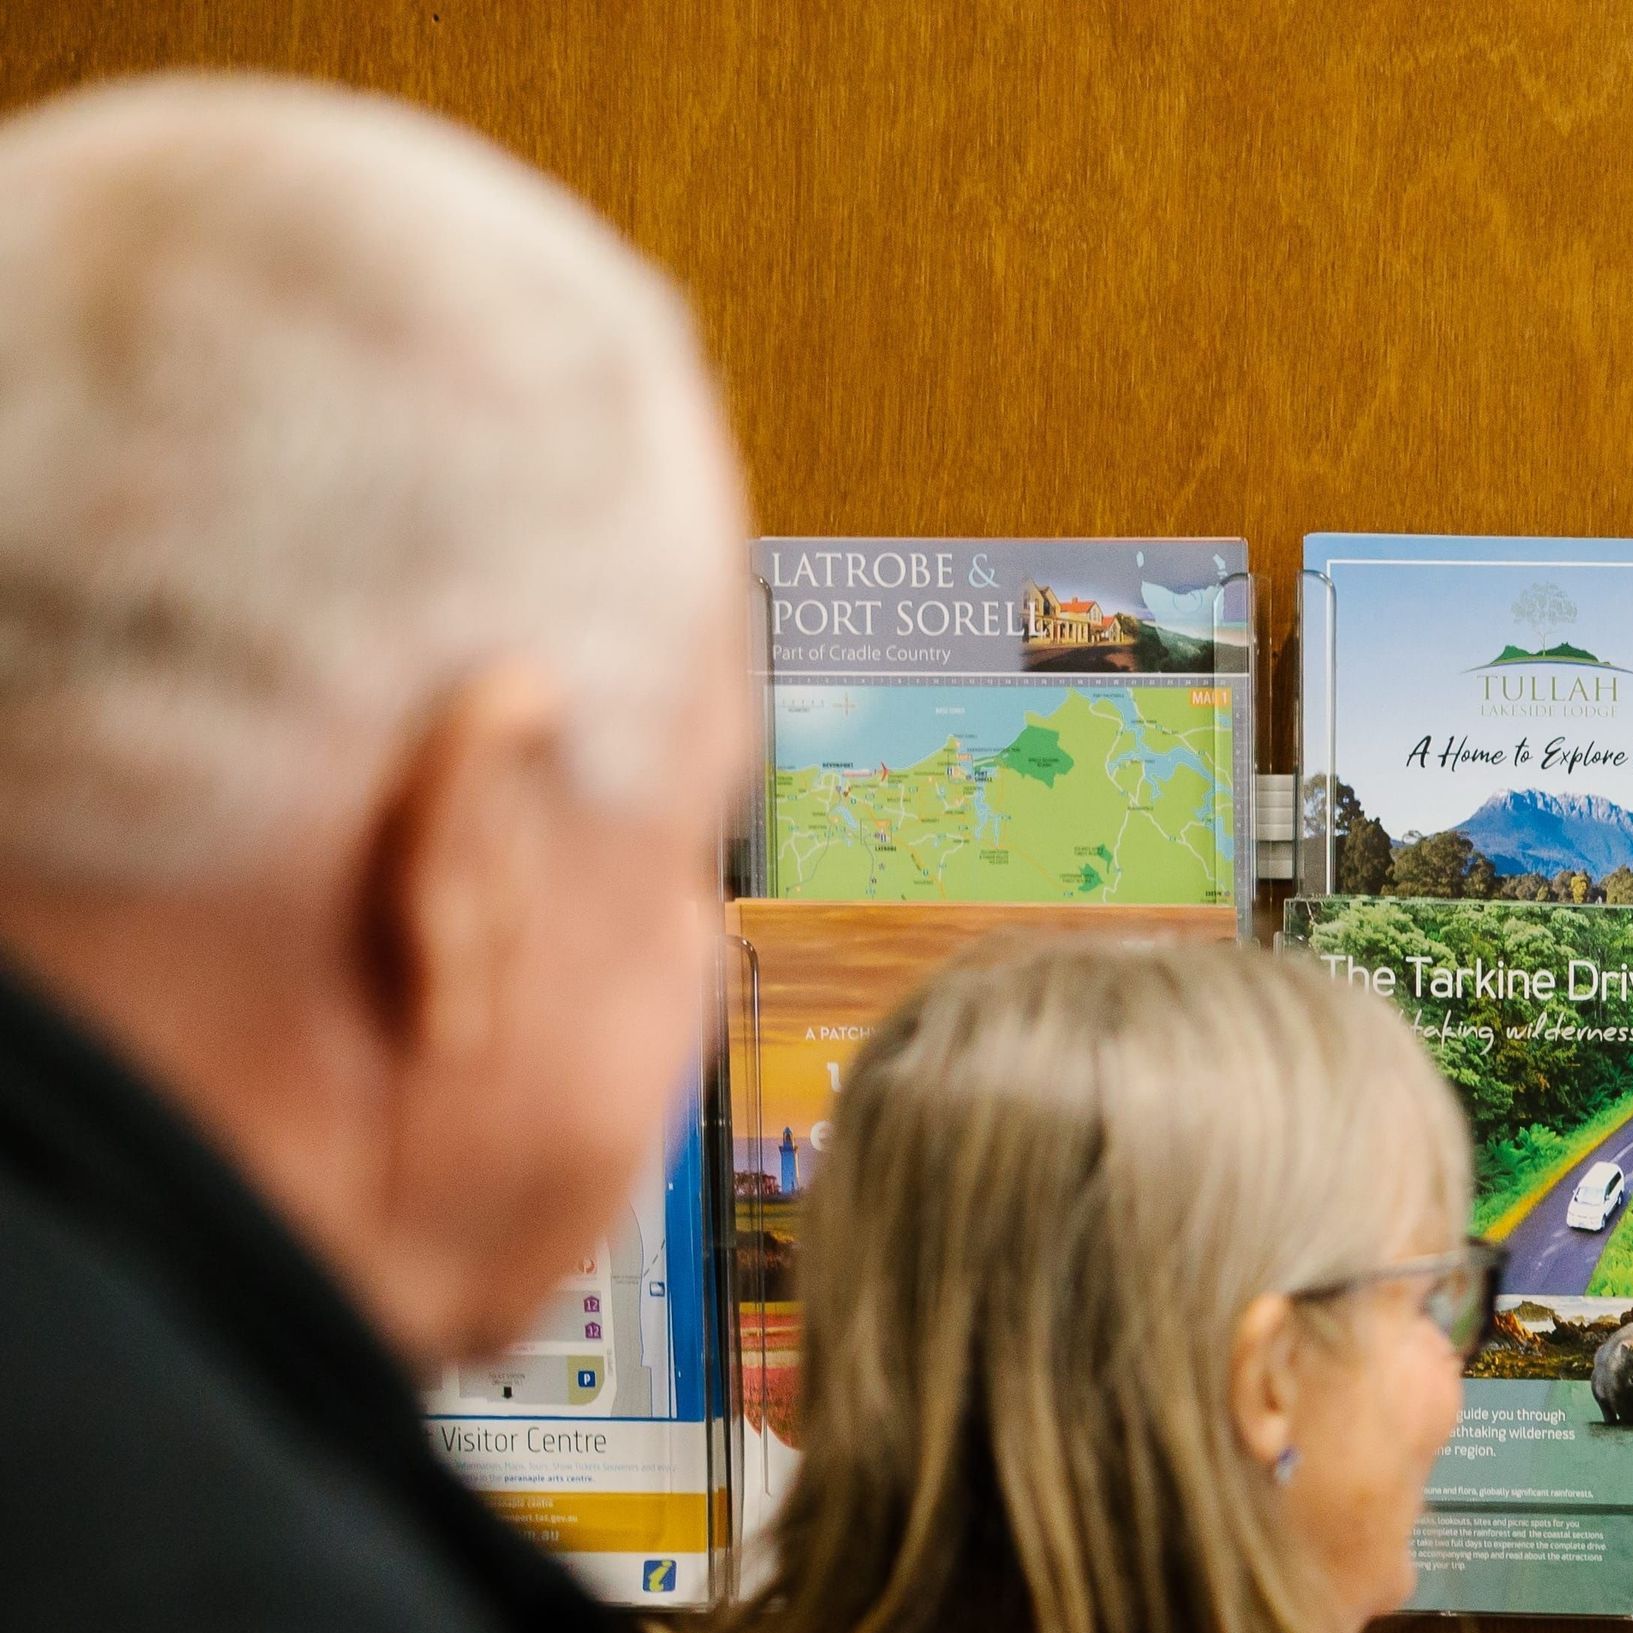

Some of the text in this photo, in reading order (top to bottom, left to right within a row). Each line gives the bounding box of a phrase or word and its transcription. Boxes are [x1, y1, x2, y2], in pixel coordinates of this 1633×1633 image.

[771, 552, 1000, 589] LATROBE &
[773, 600, 1048, 637] PORT SORELL
[1477, 675, 1619, 702] TULLAH
[1480, 705, 1619, 718] LAKESIDE LODGE
[1406, 735, 1431, 768] A
[1438, 735, 1506, 772] Home
[1514, 736, 1533, 768] to
[1542, 737, 1628, 776] Explore
[1321, 954, 1396, 996] The
[1405, 957, 1556, 1000] Tarkine
[442, 1425, 607, 1456] Visitor Centre
